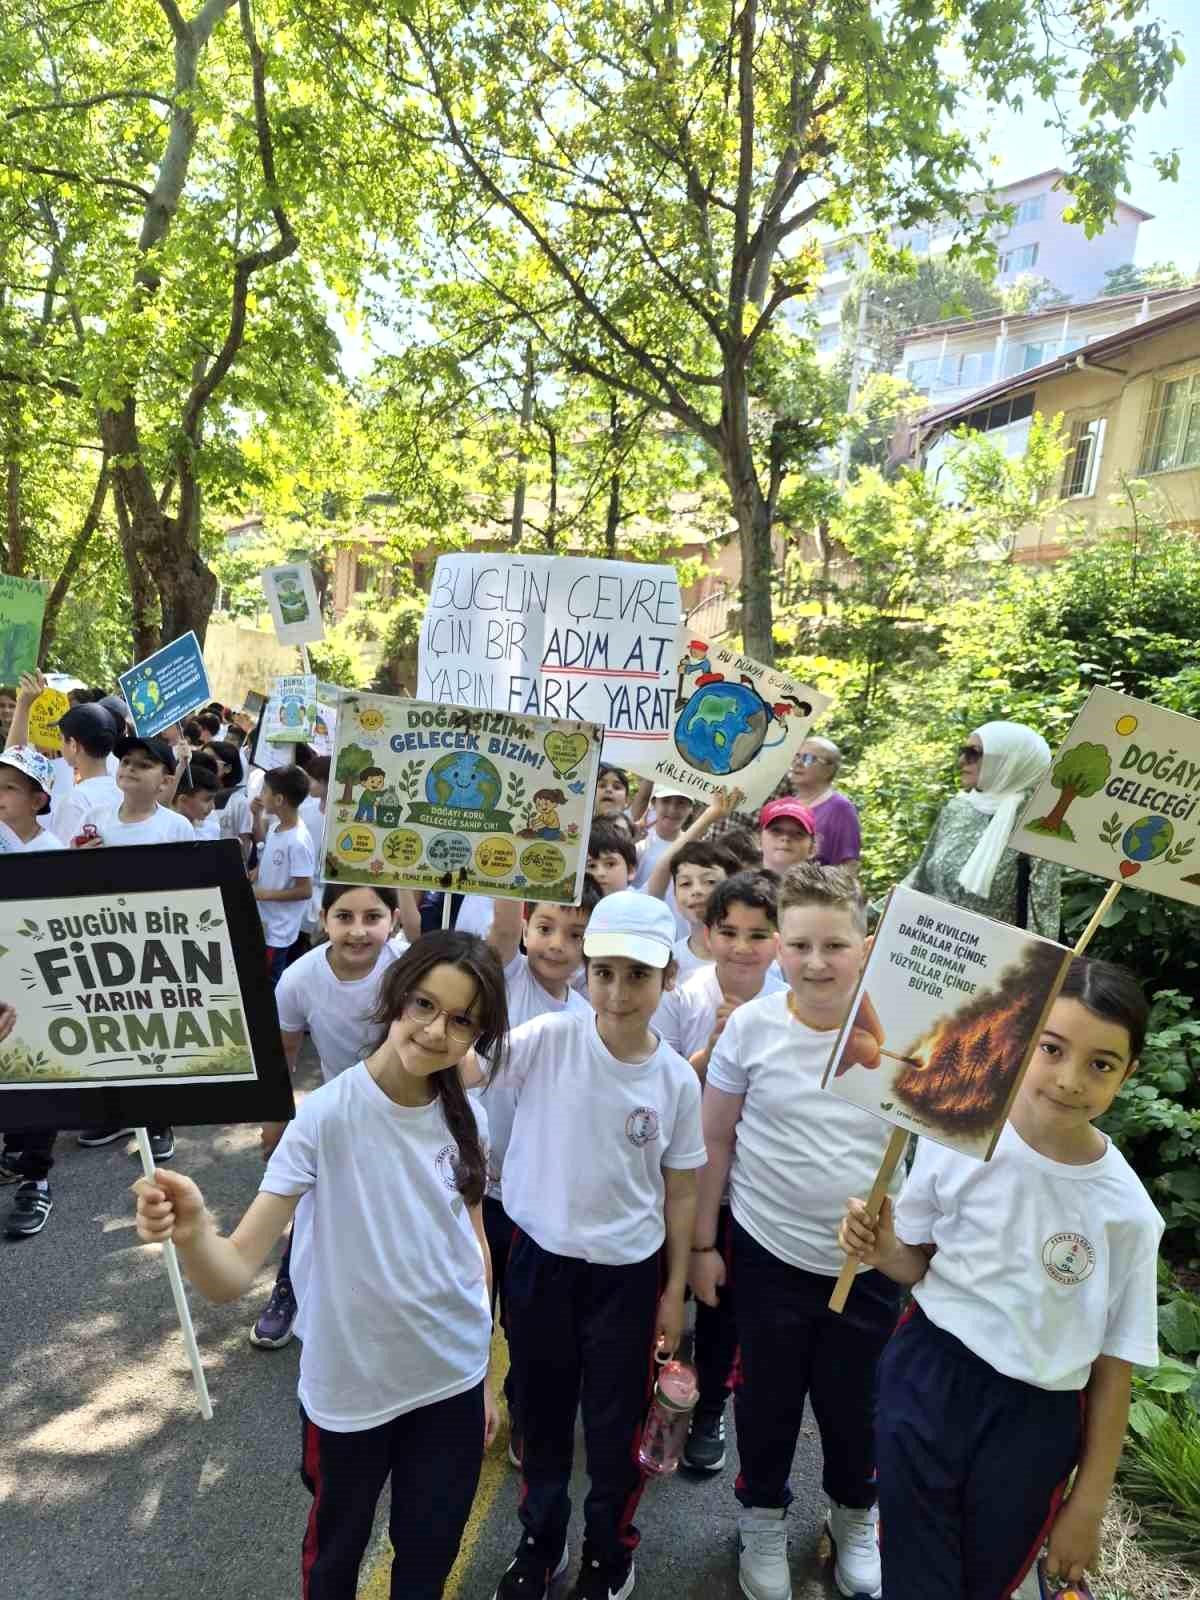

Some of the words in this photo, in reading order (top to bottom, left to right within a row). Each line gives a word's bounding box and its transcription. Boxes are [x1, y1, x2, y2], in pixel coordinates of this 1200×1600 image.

[432, 564, 550, 614] BUGÜN
[567, 575, 678, 625] ÇEVRE
[426, 615, 471, 660] İÇİN
[485, 619, 528, 660] BİR
[542, 628, 609, 669] ADIM
[624, 634, 673, 676] AT,
[425, 668, 494, 712] YARIN
[508, 676, 588, 720] FARK
[603, 681, 676, 730] YARAT
[390, 732, 480, 753] GELECEK
[488, 738, 546, 770] BİZİM!
[47, 907, 137, 942] BUGÜN
[146, 906, 189, 935] BİR
[898, 923, 952, 952] DAKİKALAR
[953, 943, 989, 968] İÇİNDE,
[916, 915, 935, 930] BİR
[935, 921, 980, 947] KIVILCIM
[889, 951, 941, 981] YÜZYILLAR
[943, 972, 977, 995] İÇİNDE
[910, 945, 928, 960] BİR
[929, 952, 967, 974] ORMAN
[76, 989, 153, 1014] YARIN
[161, 984, 204, 1009] BİR
[908, 976, 944, 999] BÜYÜR.
[47, 1008, 247, 1056] ORMAN
